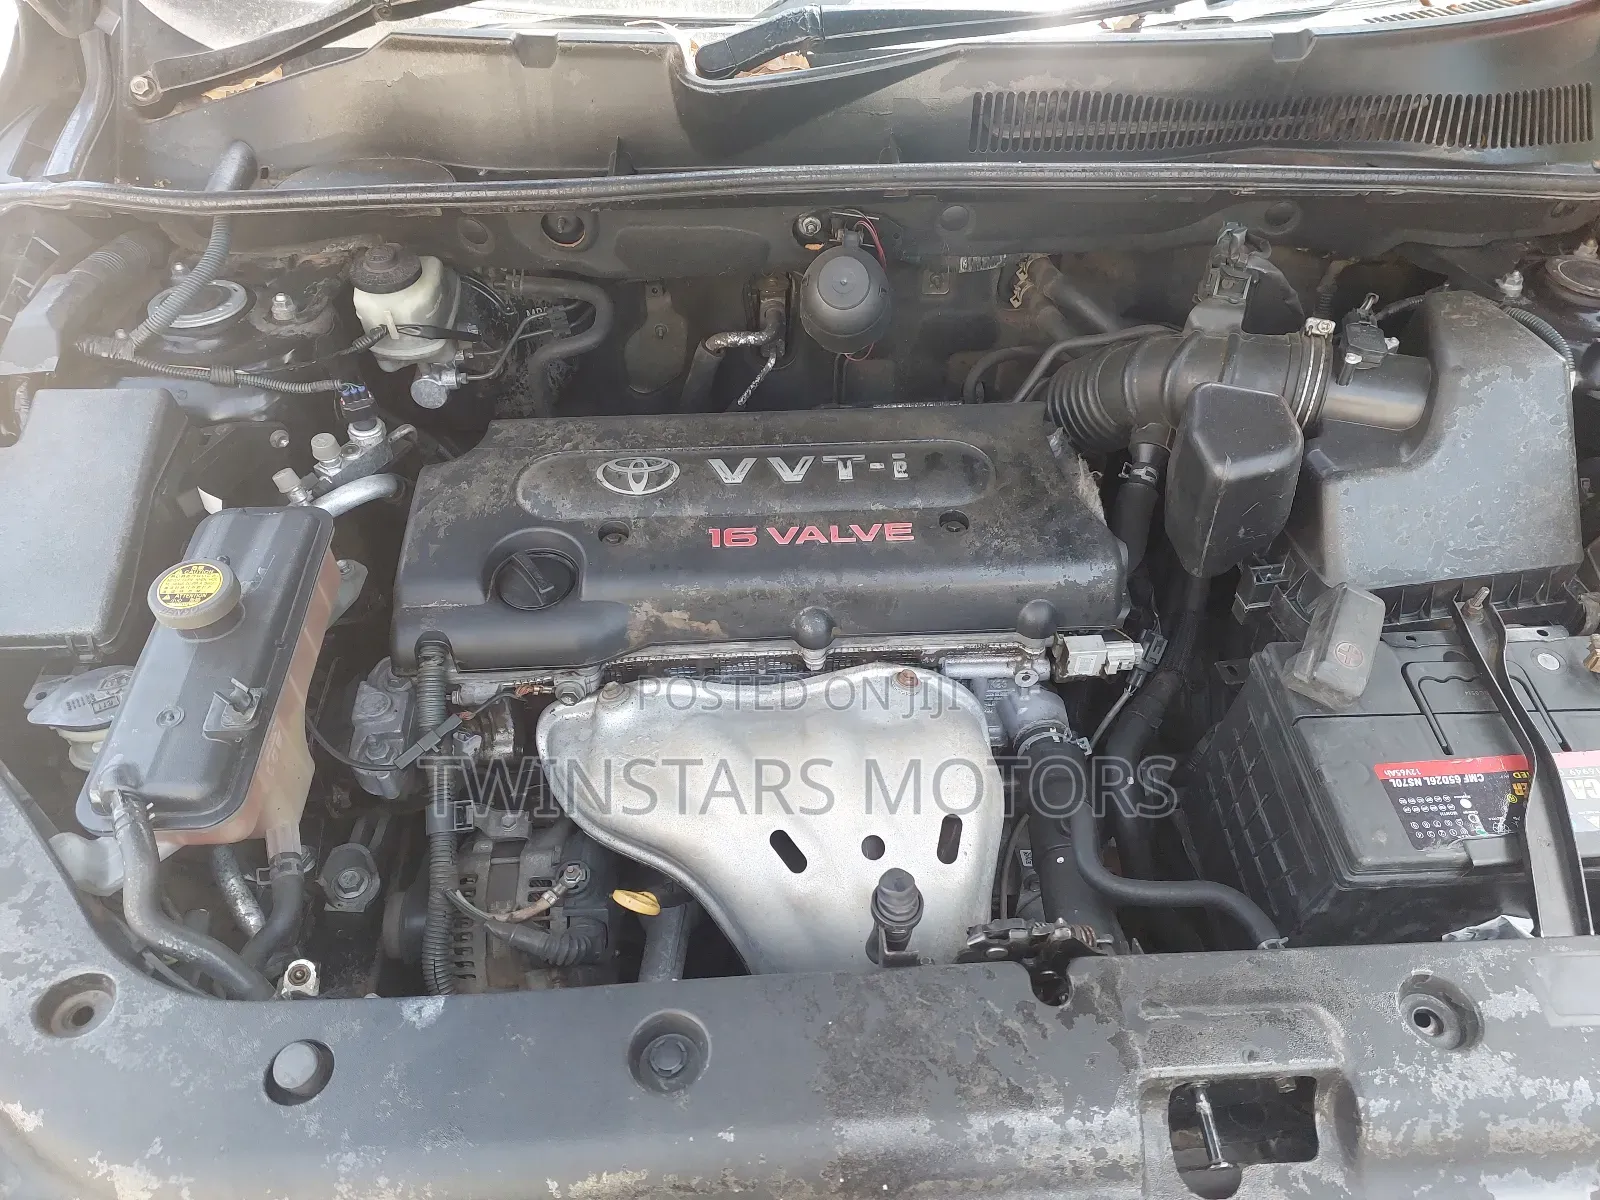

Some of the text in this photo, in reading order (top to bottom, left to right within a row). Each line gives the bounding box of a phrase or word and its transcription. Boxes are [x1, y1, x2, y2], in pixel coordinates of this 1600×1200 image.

[708, 453, 909, 484] VVT-i
[708, 522, 915, 548] 16 VALVE
[1384, 768, 1422, 778] 12V65Ah
[1389, 774, 1485, 788] CMF 65D26L NS70L
